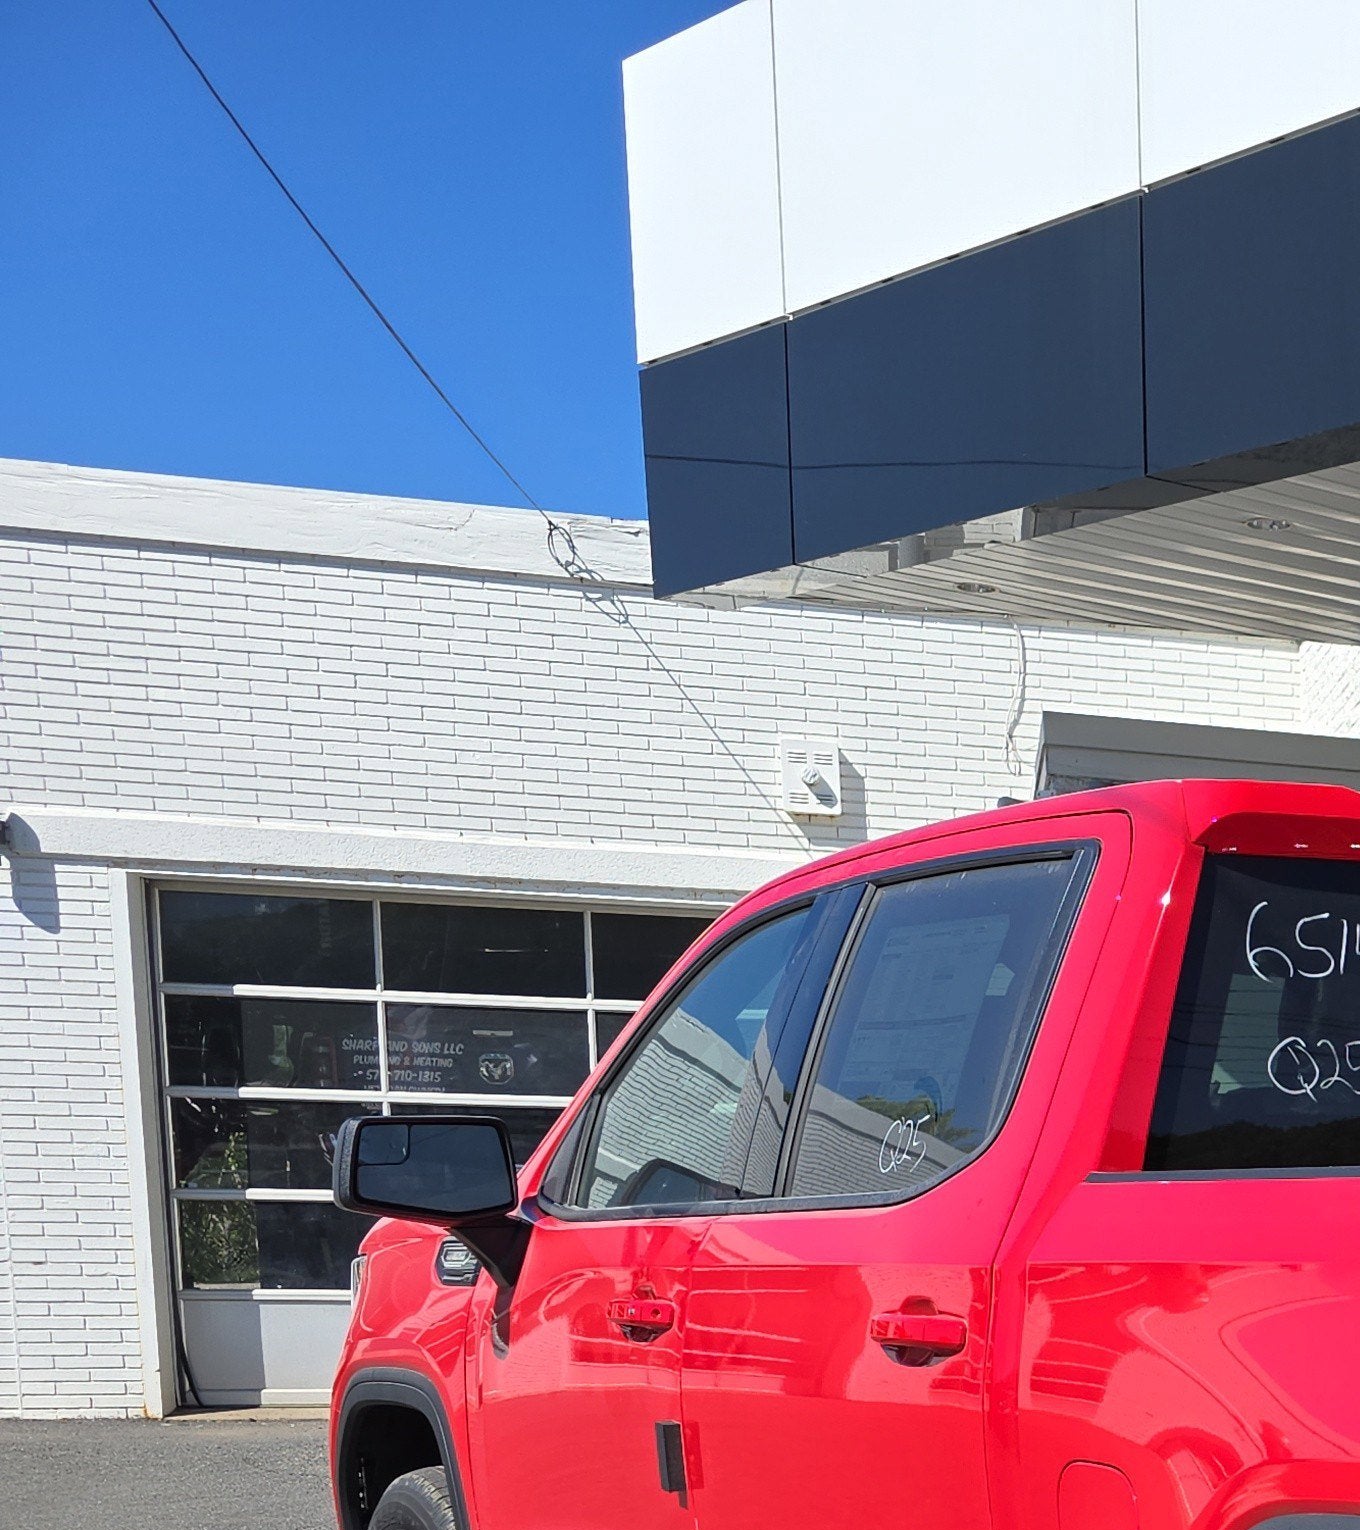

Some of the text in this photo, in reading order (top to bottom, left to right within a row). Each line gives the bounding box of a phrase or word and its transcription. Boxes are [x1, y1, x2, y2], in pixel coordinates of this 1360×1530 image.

[411, 1041, 443, 1054] SONS
[443, 1043, 465, 1055] LLC
[353, 1054, 401, 1067] PLUMNG
[412, 1057, 453, 1068] HEATING
[365, 1068, 442, 1082] 57-710-1315
[879, 1114, 931, 1173] Q25
